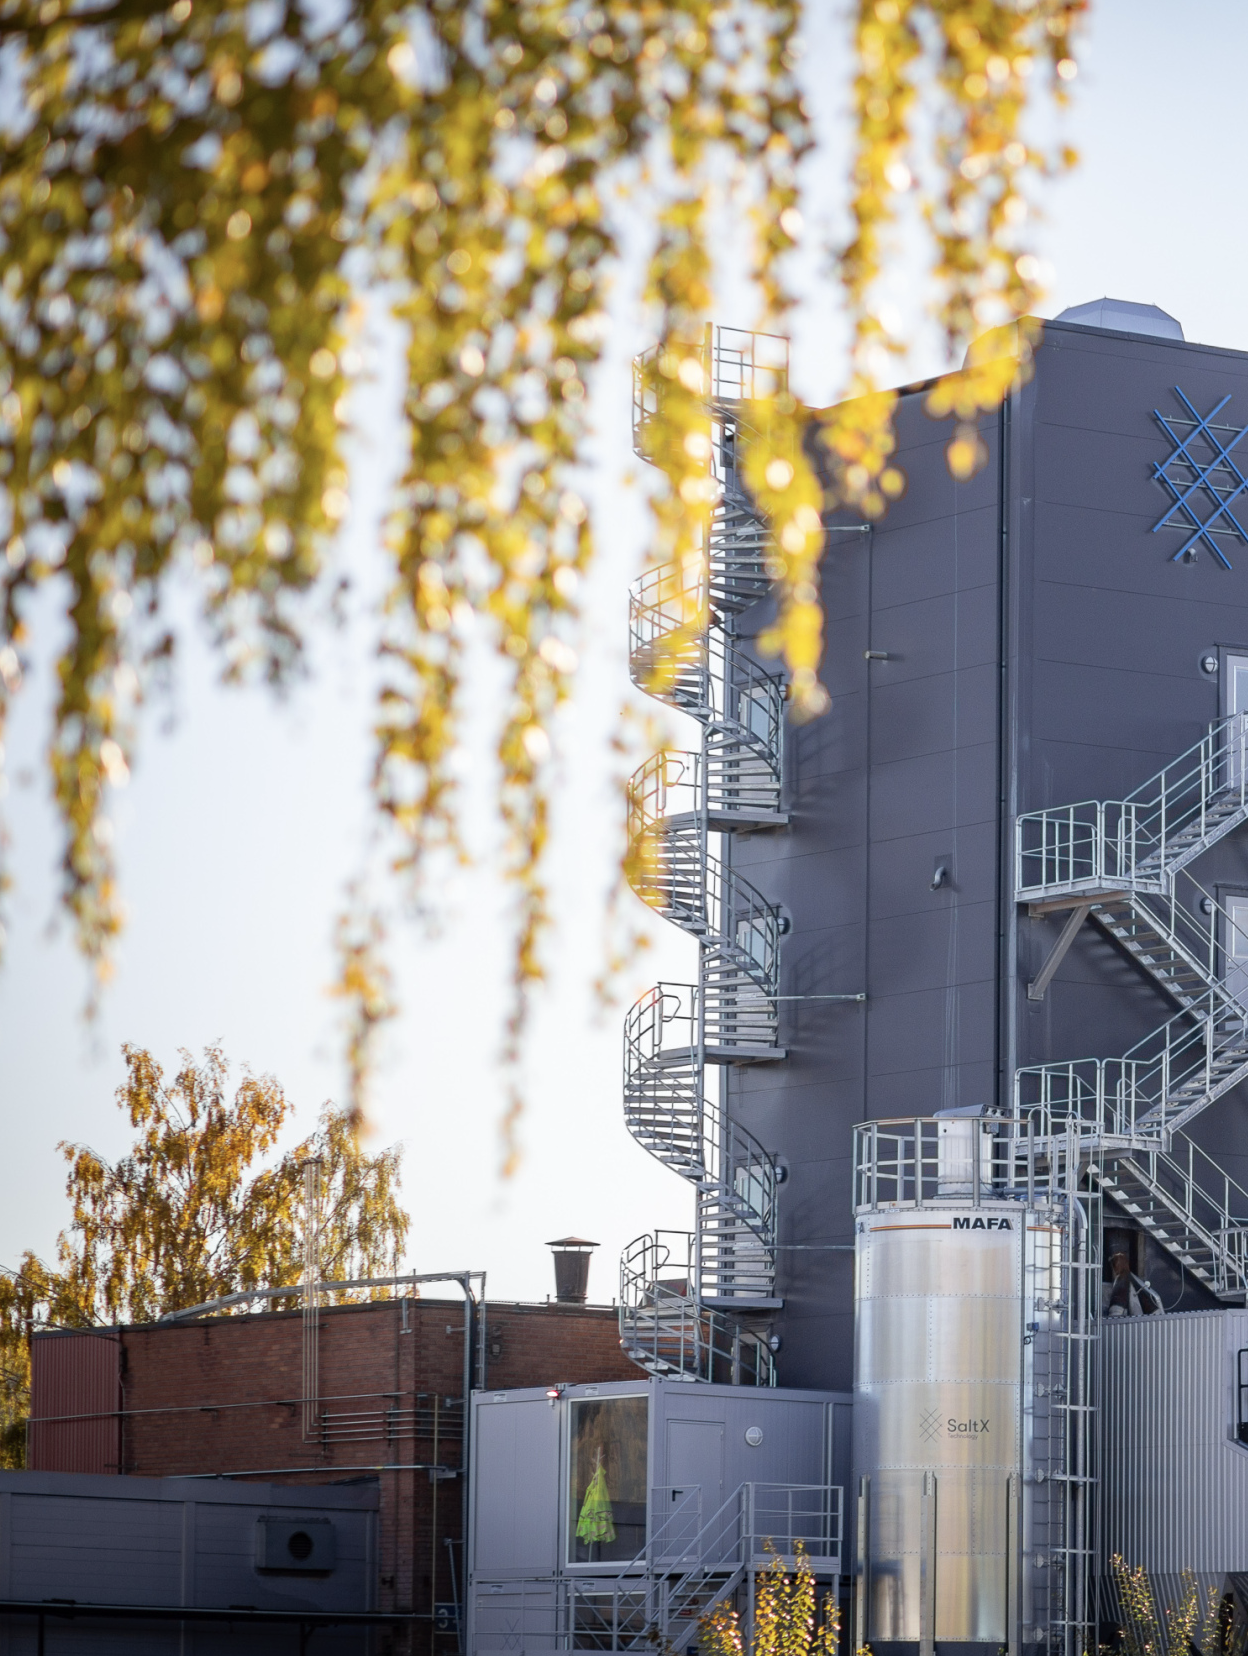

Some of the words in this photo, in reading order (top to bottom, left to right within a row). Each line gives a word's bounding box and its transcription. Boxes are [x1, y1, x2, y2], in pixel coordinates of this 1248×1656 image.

[953, 1217, 1014, 1230] MAFA
[947, 1418, 990, 1433] SaltX
[947, 1432, 979, 1440] Technology
